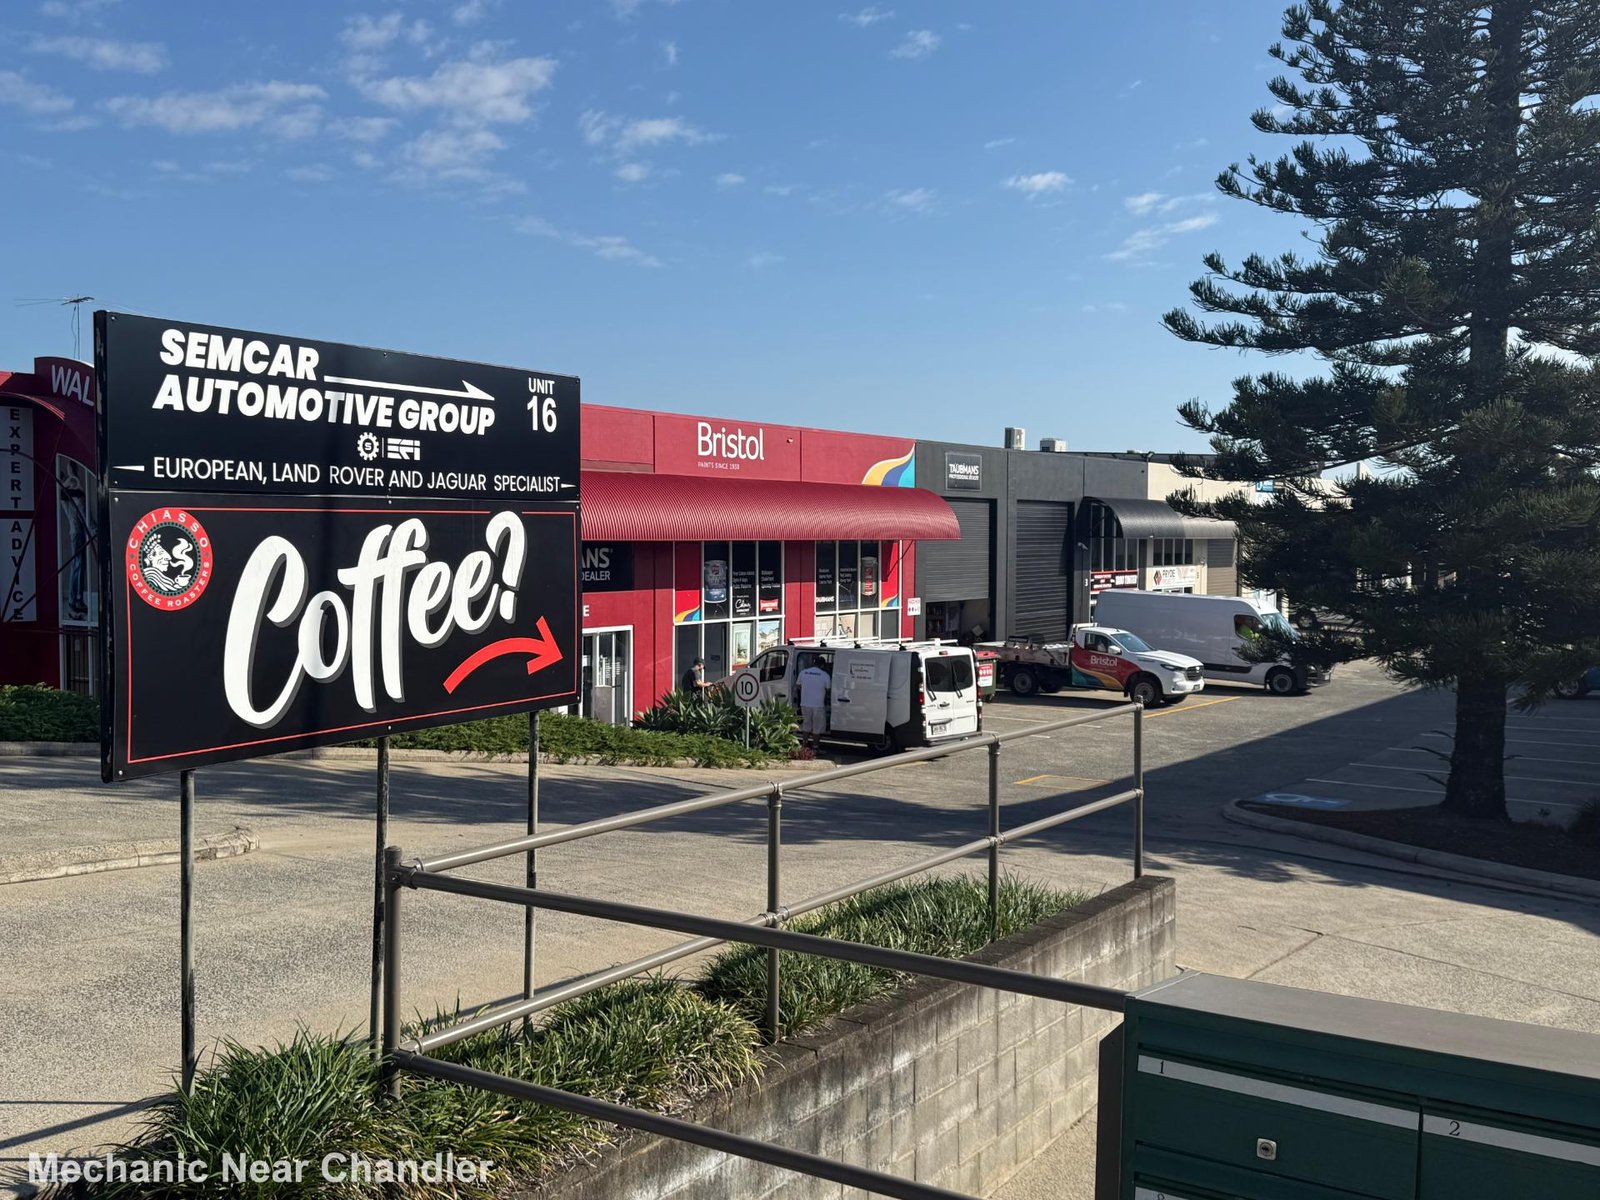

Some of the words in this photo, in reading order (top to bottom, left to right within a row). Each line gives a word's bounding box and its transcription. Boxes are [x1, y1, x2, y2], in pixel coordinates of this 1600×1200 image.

[159, 328, 320, 381] SEMCAR
[51, 364, 95, 407] WAL
[152, 374, 395, 428] AUTOMOTIVE
[398, 399, 496, 436] GROUP
[528, 376, 556, 395] UNIT
[527, 395, 558, 433] 16
[9, 408, 22, 509] EXPERT
[697, 421, 765, 461] Bristol
[153, 456, 268, 485] EUROPEAN,
[272, 462, 321, 483] LAND
[329, 465, 384, 487] ROVER
[388, 469, 423, 489] AND
[427, 472, 487, 491] JAGUAR
[494, 474, 561, 493] SPECIALIST
[949, 463, 980, 475] TAUBMANS
[129, 509, 209, 549] CHIASSO
[10, 520, 24, 620] ADVICE
[129, 563, 162, 606] COFFEE
[167, 561, 210, 608] ROASTERS
[223, 510, 528, 729] Coffee?
[1090, 655, 1118, 667] Bristol
[741, 681, 753, 695] 10
[1159, 1060, 1165, 1074] 1
[1449, 1120, 1460, 1136] 2
